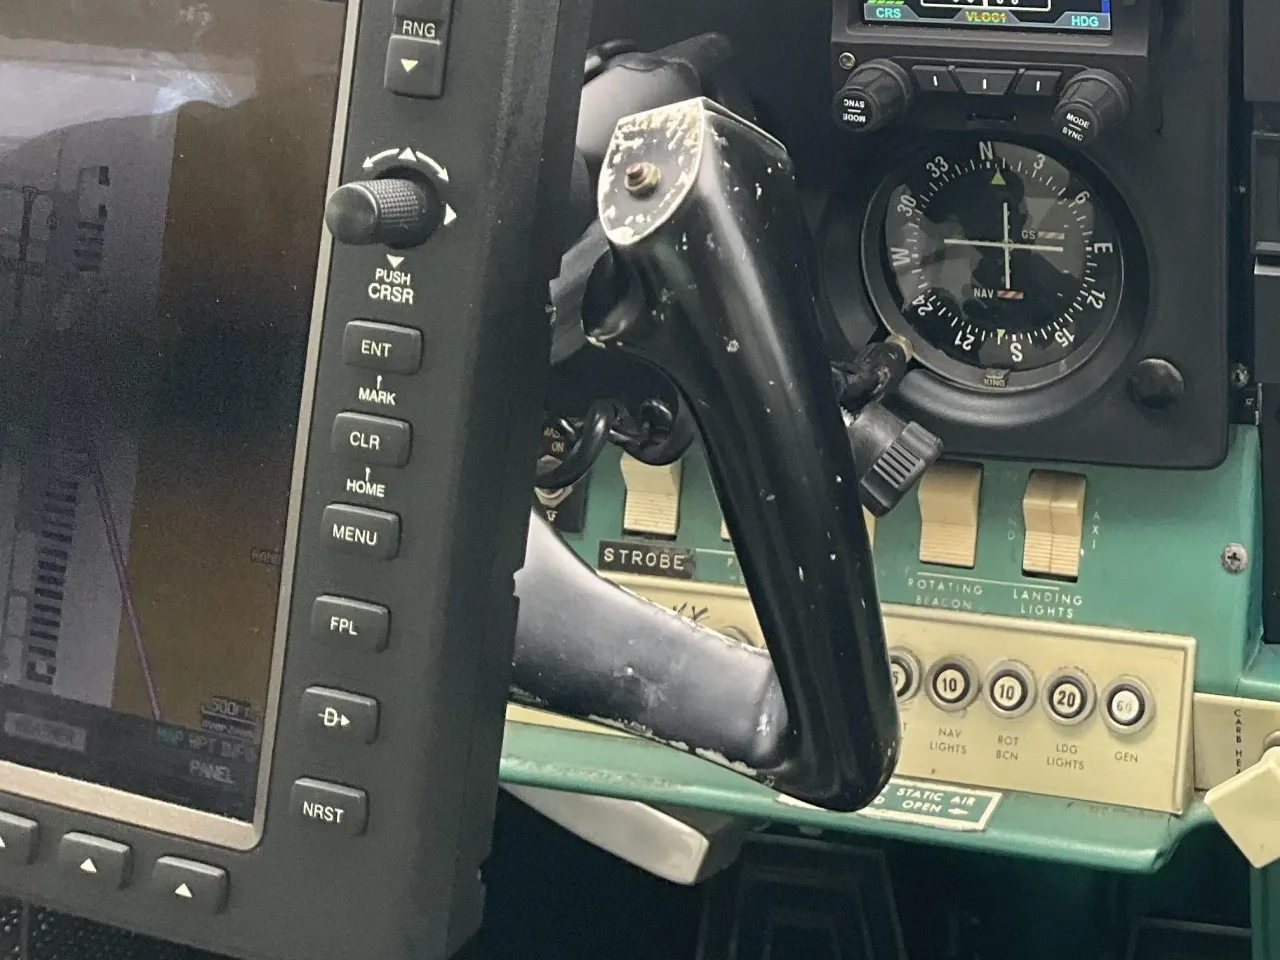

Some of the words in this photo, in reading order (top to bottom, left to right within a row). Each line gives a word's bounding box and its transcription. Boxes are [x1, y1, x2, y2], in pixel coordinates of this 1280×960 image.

[876, 8, 902, 18] CRS
[1071, 16, 1098, 26] HDG
[402, 19, 436, 38] RNG
[375, 268, 411, 285] PUSH
[368, 283, 414, 304] CRSR
[973, 288, 993, 299] NAV
[361, 340, 391, 357] ENT
[359, 387, 395, 405] MARK
[350, 432, 380, 449] CLR
[347, 479, 385, 497] HOME
[332, 524, 377, 545] MENU
[604, 548, 685, 570] STROBE
[908, 578, 983, 595] ROTATING
[1014, 589, 1082, 606] LANDING
[1021, 605, 1074, 618] LIGHTS
[330, 617, 357, 635] FPL
[938, 727, 962, 738] NAV
[930, 742, 967, 755] LIGHTS
[1056, 744, 1078, 755] LDG
[1047, 757, 1084, 770] LIGHTS
[1114, 752, 1138, 763] GEN
[896, 788, 943, 801] STATIC
[950, 795, 975, 806] AIR
[303, 802, 344, 824] NRST
[902, 800, 942, 813] OPEN
